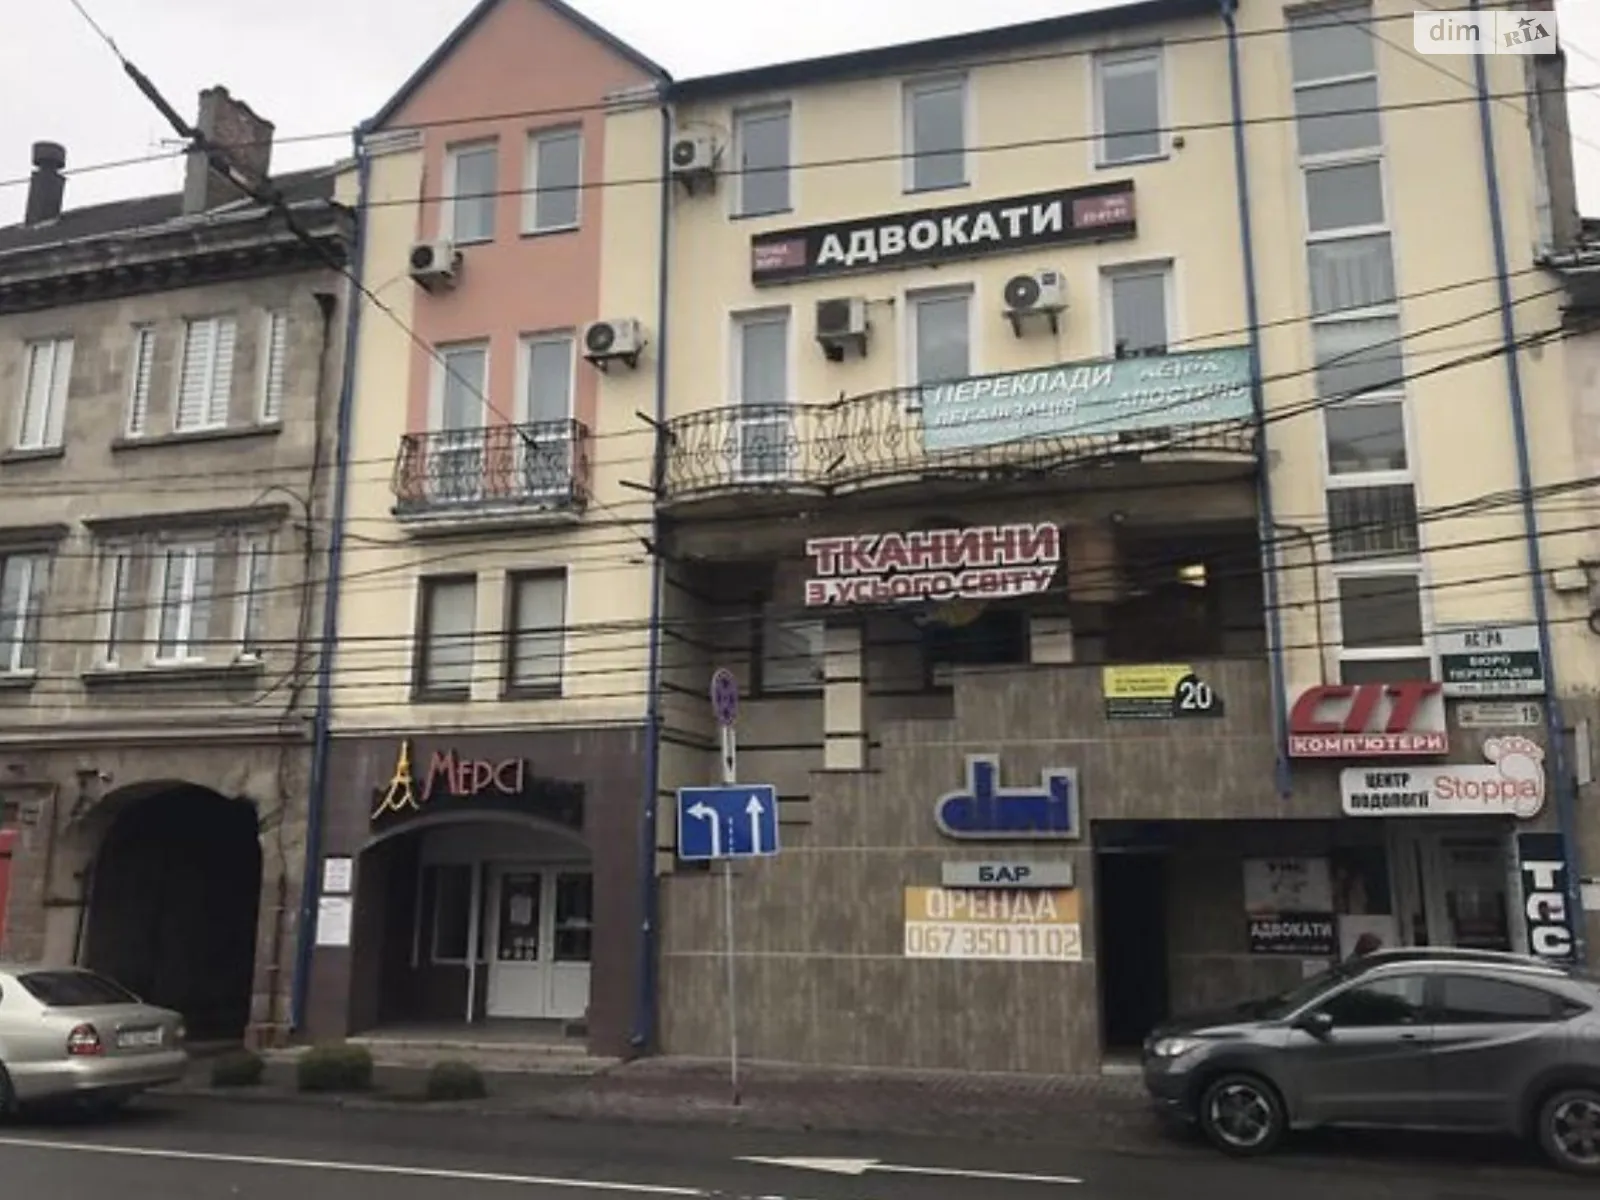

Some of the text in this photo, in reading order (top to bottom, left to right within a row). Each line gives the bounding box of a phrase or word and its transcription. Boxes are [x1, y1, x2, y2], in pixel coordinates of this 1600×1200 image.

[816, 200, 1063, 267] АДВОКАТИ
[934, 364, 1114, 405] ПЕРЕКЛАДИ
[806, 521, 1060, 576] ТКАНИНИ
[806, 565, 1057, 606] З УСЬОГО СВІТУ
[1180, 681, 1212, 709] 20
[1293, 734, 1444, 754] КОМП'ЮТЕРИ
[1365, 772, 1410, 789] ЦЕНТР
[1434, 775, 1537, 803] Stoppa
[978, 865, 1031, 882] БАР
[925, 889, 1057, 924] ОРЕНДА
[1250, 921, 1332, 940] АДВОКАТИ
